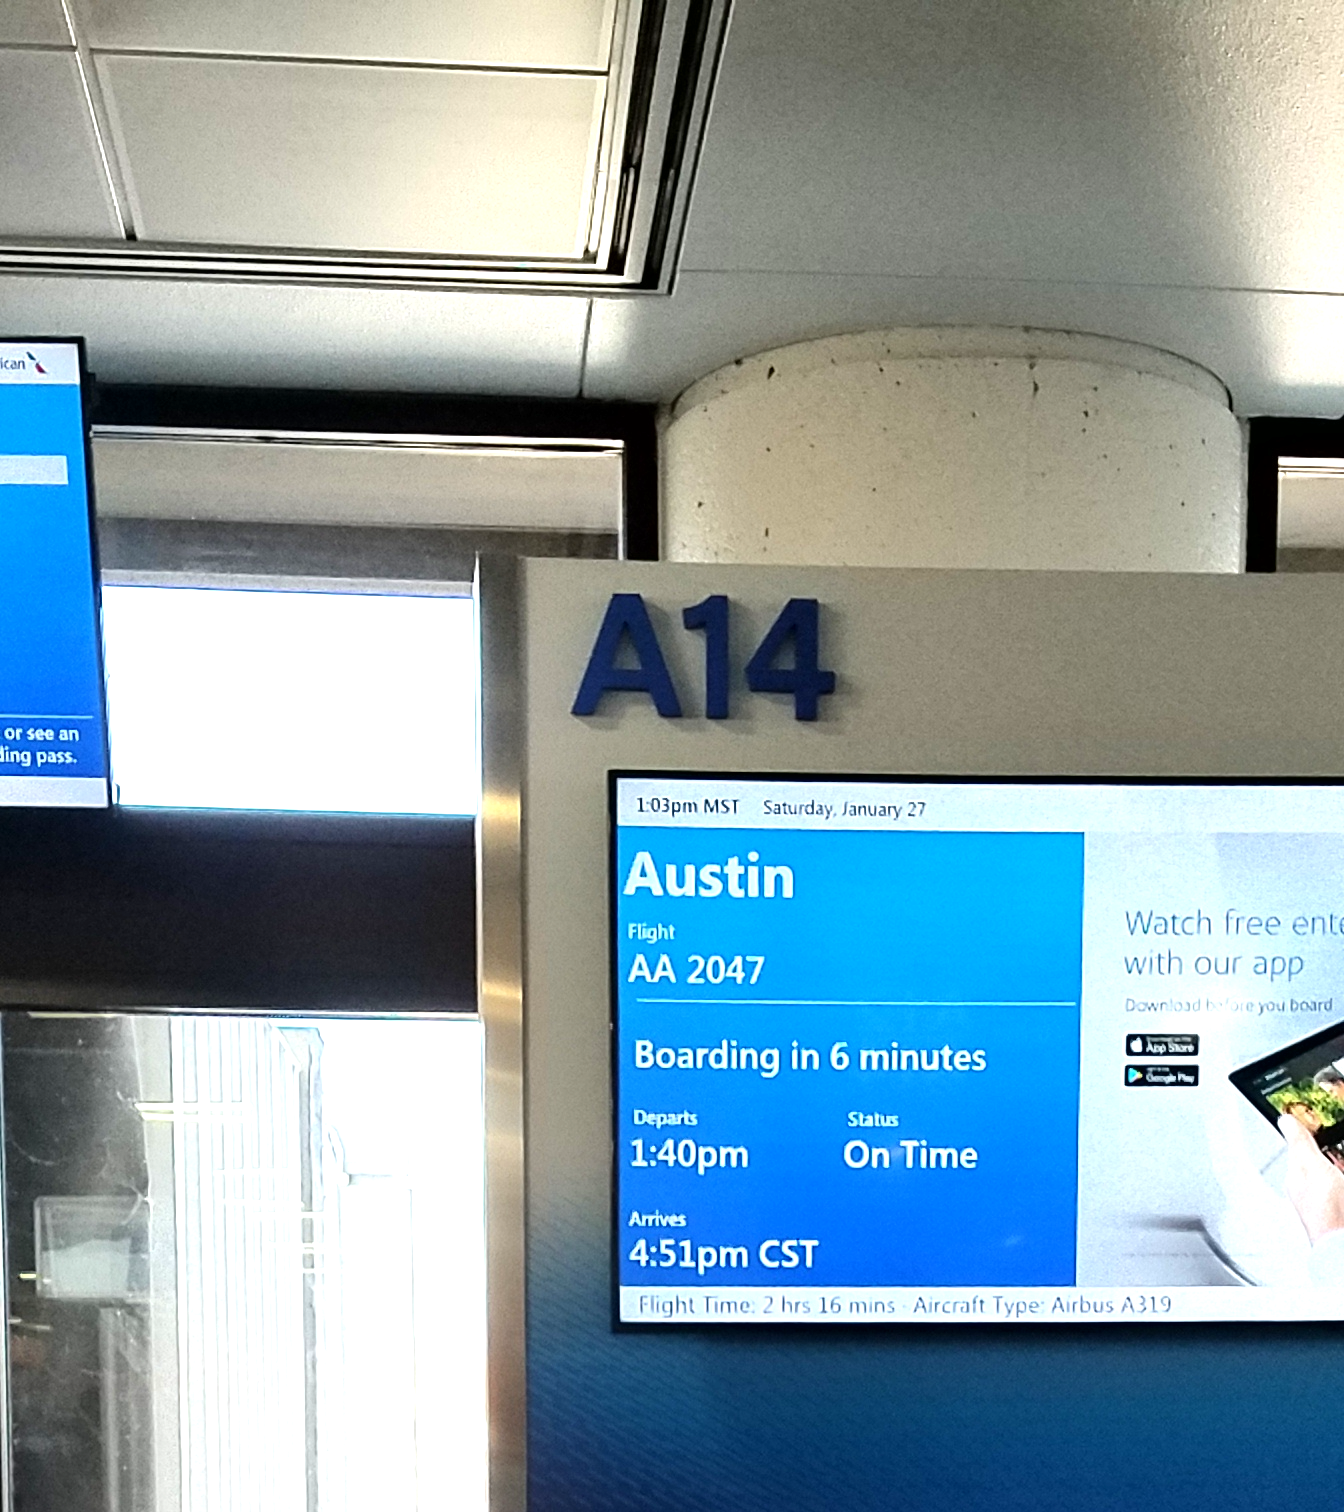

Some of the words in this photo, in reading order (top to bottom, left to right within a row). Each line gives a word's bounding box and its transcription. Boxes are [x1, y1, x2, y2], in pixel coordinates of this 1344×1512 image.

[571, 593, 836, 722] A14
[4, 729, 22, 740] or
[27, 729, 53, 741] see
[58, 730, 79, 742] an
[36, 751, 77, 766] pass.
[637, 797, 698, 818] 1:03pm
[704, 798, 740, 815] MST
[763, 800, 838, 820] Saturday,
[842, 802, 902, 821] January
[908, 802, 926, 818] 27
[623, 851, 794, 899] Austin
[628, 924, 675, 944] Flight
[1126, 910, 1212, 937] Watch
[1225, 909, 1281, 937] free
[628, 954, 675, 984] AA
[688, 956, 764, 985] 2047
[1125, 950, 1183, 976] with
[1194, 953, 1242, 976] our
[1253, 955, 1304, 982] app
[1126, 999, 1200, 1013] Download
[1258, 1001, 1286, 1015] you
[1290, 998, 1333, 1012] board
[635, 1041, 780, 1077] Boarding
[792, 1042, 819, 1071] in
[830, 1043, 849, 1071] 6
[860, 1043, 986, 1073] minutes
[634, 1109, 697, 1128] Departs
[848, 1111, 898, 1128] Status
[630, 1139, 748, 1175] 1:40pm
[844, 1139, 890, 1169] On
[899, 1140, 978, 1170] Time
[629, 1211, 686, 1228] Arrives
[629, 1238, 749, 1275] 4:51pm
[759, 1239, 818, 1269] CST
[640, 1296, 696, 1319] Flight
[703, 1296, 755, 1316] Time:
[763, 1297, 774, 1314] 2
[781, 1296, 812, 1315] hrs
[819, 1296, 842, 1314] 16
[849, 1297, 896, 1315] mins
[914, 1295, 985, 1315] Aircraft
[991, 1296, 1045, 1319] Type:
[1052, 1295, 1114, 1315] Airbus
[1122, 1296, 1172, 1315] A319
